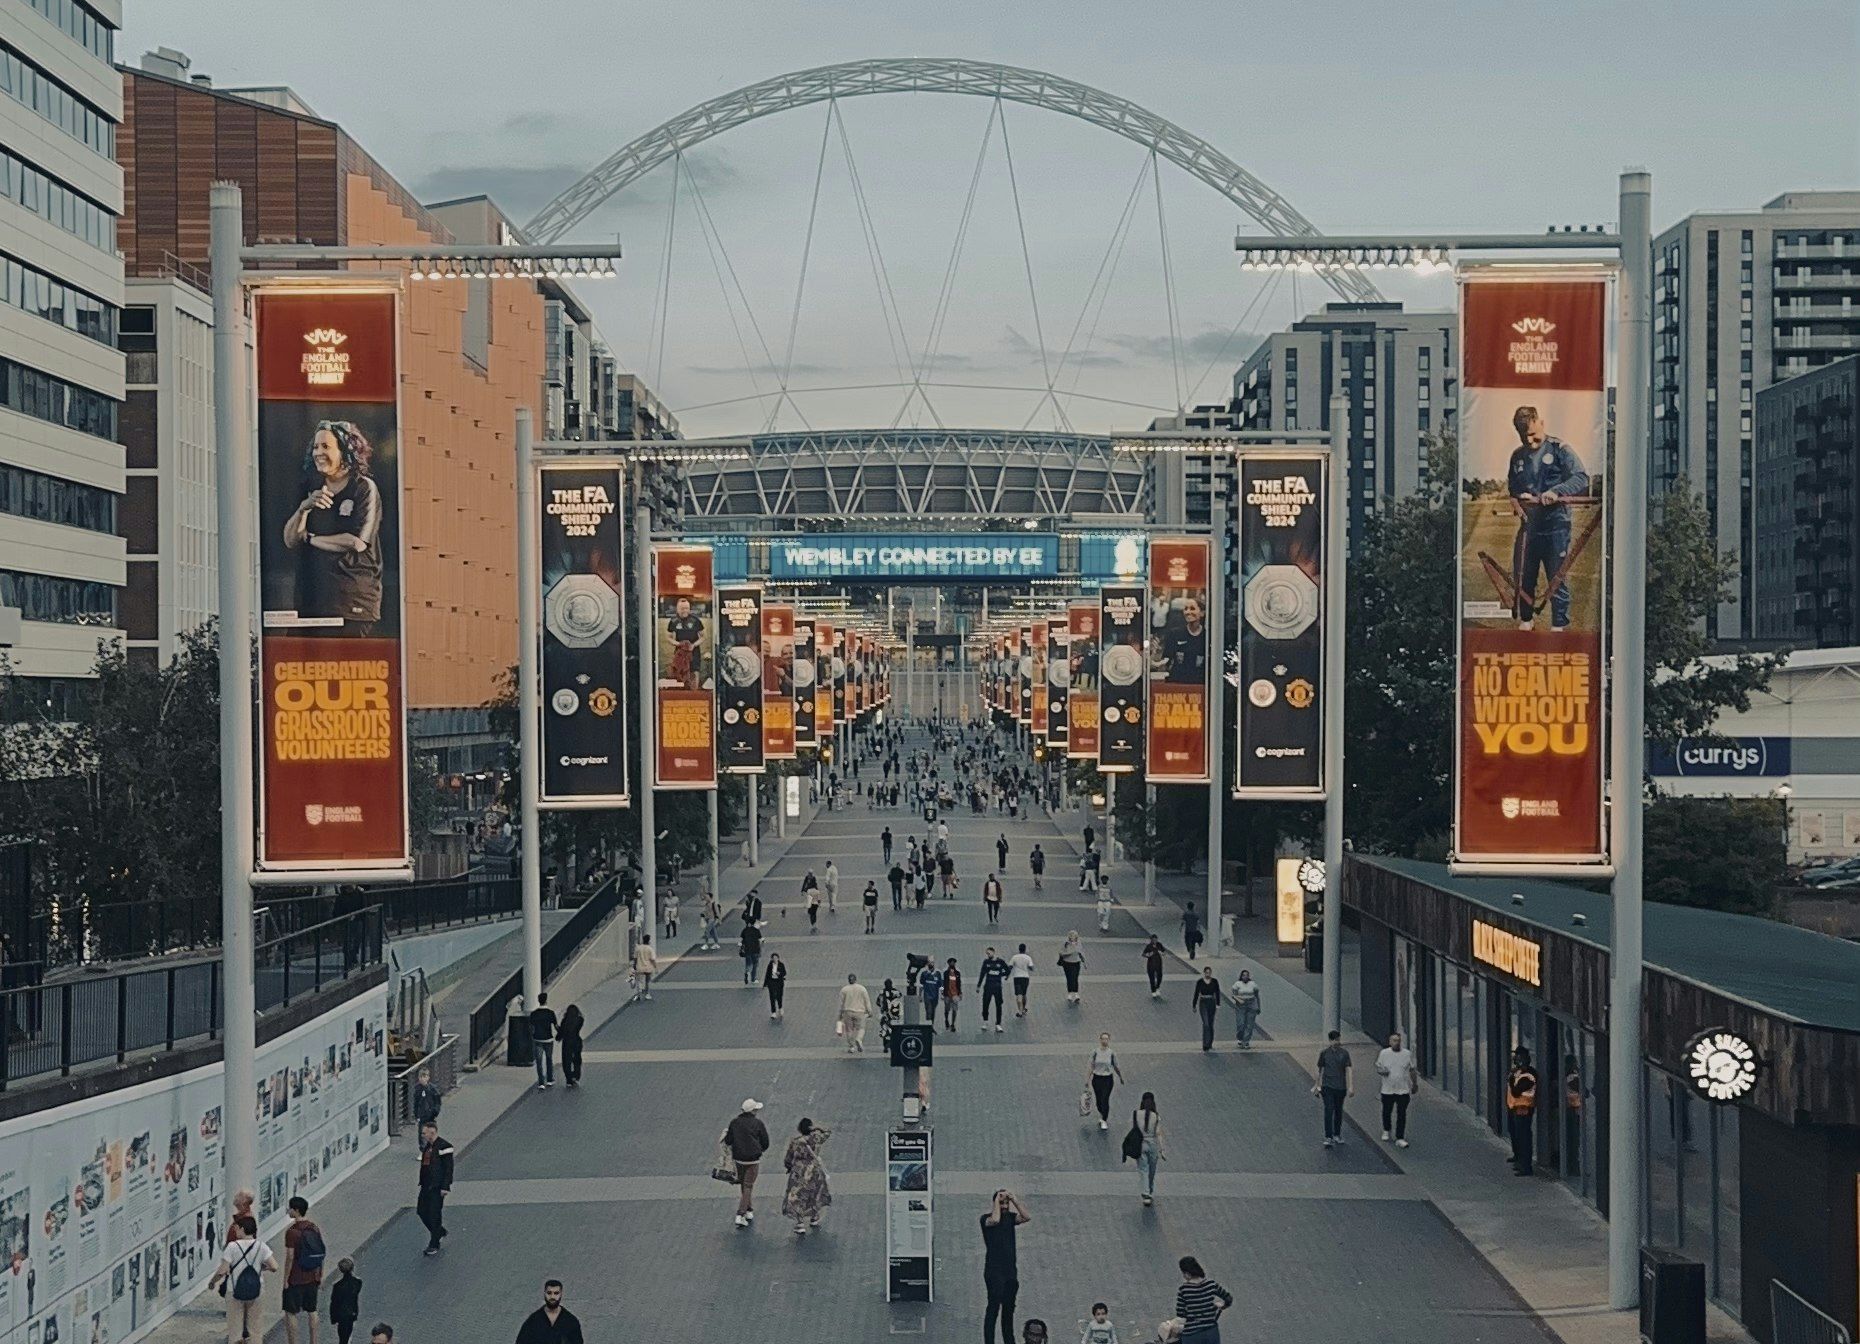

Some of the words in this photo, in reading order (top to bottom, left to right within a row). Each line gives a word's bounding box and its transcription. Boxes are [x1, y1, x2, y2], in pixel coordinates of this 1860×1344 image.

[1510, 342, 1558, 352] ENGLAND
[302, 353, 350, 363] ENGLAND
[1508, 352, 1559, 362] FOOTBALL
[301, 363, 351, 373] FOOTBALL
[1515, 362, 1553, 373] FAMILY
[1252, 480, 1282, 493] THE
[1284, 476, 1309, 493] FA
[552, 490, 581, 503] THE
[583, 486, 608, 503] FA
[1246, 493, 1316, 505] COMMUNITY
[547, 503, 615, 514] COMMUNITY
[1261, 504, 1301, 516] SHIELD
[561, 514, 601, 525] SHIELD
[1265, 516, 1296, 527] 2024
[566, 525, 596, 536] 2024
[784, 547, 876, 566] WEMBLEY
[879, 547, 991, 565] CONNECTED
[993, 547, 1018, 565] BY
[1019, 547, 1043, 565] EE
[1473, 653, 1589, 666] THERE'S
[274, 661, 389, 680] CELEBRATING
[1474, 666, 1502, 696] NO
[1507, 666, 1589, 696] GAME
[274, 680, 389, 710] OUR
[1474, 696, 1589, 723] WITHOUT
[275, 710, 390, 740] GRASSROOTS
[663, 722, 710, 739] MORE
[1473, 723, 1588, 754] YOU
[276, 739, 390, 760] VOLUNTEERS
[1266, 747, 1305, 758] cognizant
[570, 756, 608, 766] cognizant
[1684, 748, 1760, 770] currys
[1690, 1038, 1717, 1077] BLACK
[1714, 1034, 1753, 1059] SHEEP
[1708, 1070, 1756, 1100] COFFEE
